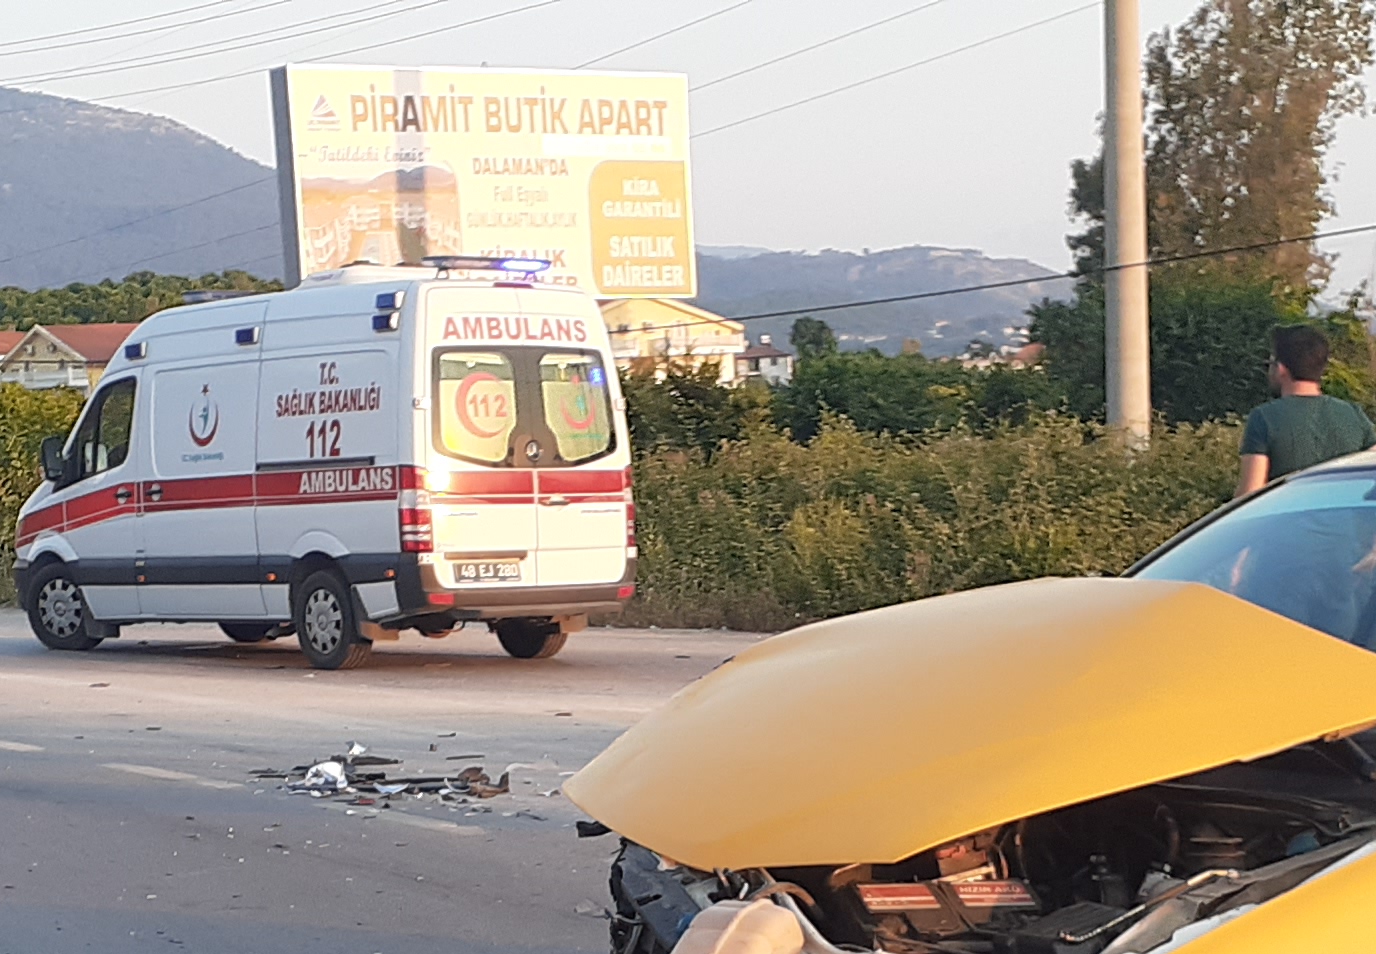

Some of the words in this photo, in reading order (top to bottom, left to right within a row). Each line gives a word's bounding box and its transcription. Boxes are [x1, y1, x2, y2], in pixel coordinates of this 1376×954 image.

[350, 83, 474, 133] PİRAMİT
[484, 86, 569, 134] BUTİK
[577, 98, 668, 137] APART
[621, 176, 660, 197] KİRA
[601, 198, 682, 219] GARANTİLİ
[608, 235, 675, 258] SATILIK
[601, 260, 685, 288] DAİRELER
[442, 317, 587, 343] AMBULANS
[319, 361, 340, 386] T.C.
[275, 387, 316, 418] SAĞLIK
[319, 381, 381, 415] BAKANLIĞI
[468, 394, 508, 418] 112
[305, 419, 341, 459] 112
[299, 467, 394, 494] AMBULANS
[479, 564, 494, 577] EJ
